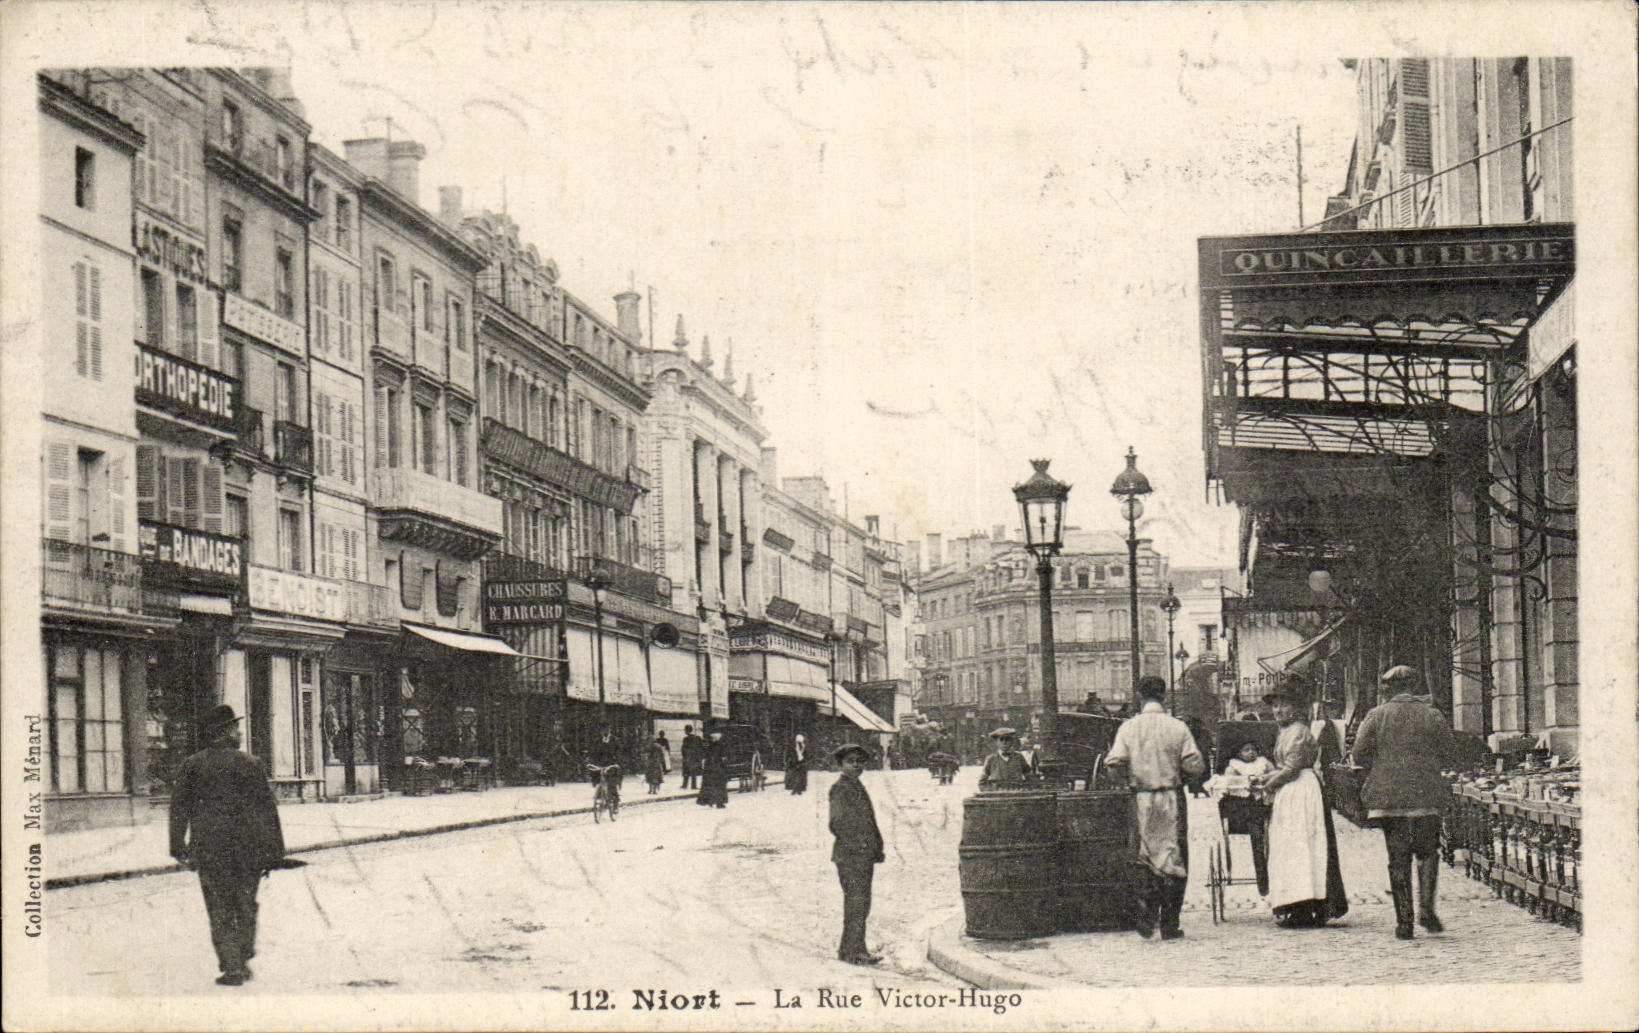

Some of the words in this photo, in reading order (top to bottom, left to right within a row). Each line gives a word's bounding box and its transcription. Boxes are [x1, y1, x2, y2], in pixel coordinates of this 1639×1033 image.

[1234, 240, 1565, 275] QUINCAILLERIE
[173, 528, 241, 576] BANDAGES
[487, 582, 563, 598] CHAUSSURES
